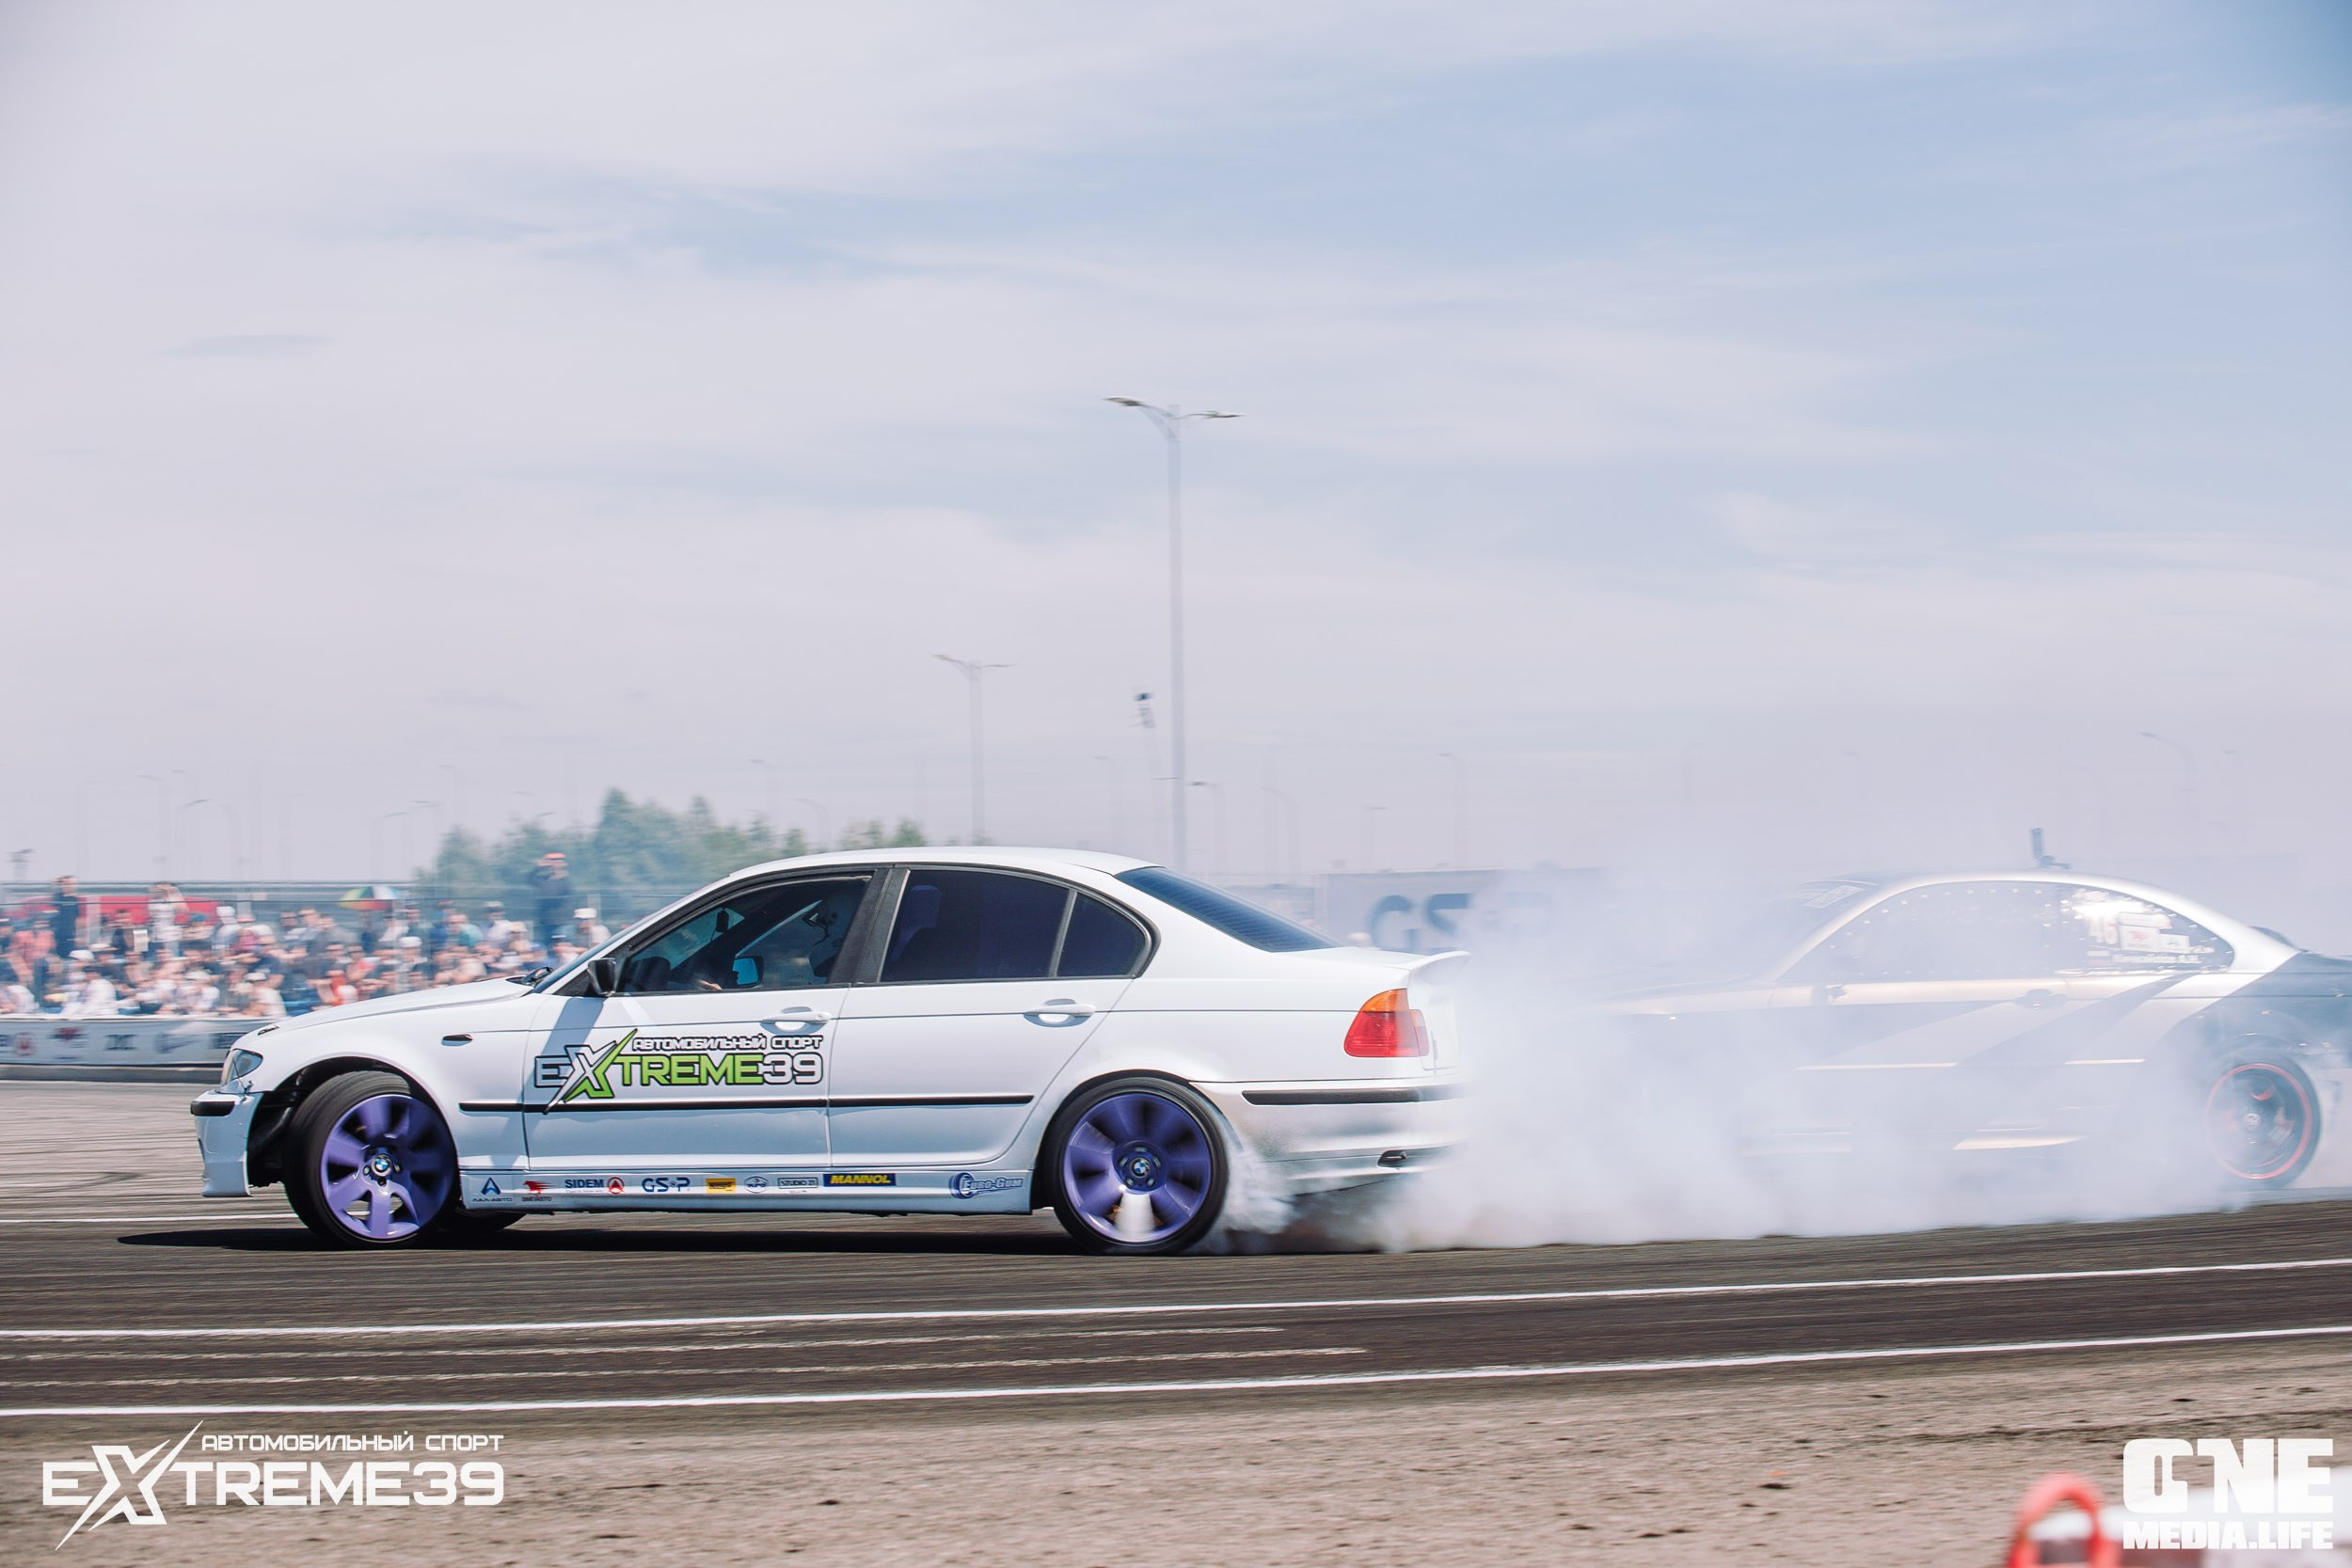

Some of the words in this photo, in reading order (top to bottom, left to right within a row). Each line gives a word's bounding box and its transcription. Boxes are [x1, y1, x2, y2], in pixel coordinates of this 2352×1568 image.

[631, 1034, 766, 1051] АВТОМОБИЛЬНЫЙ
[771, 1036, 823, 1050] СПОРТ
[535, 1028, 824, 1115] EXTREME39
[564, 1179, 604, 1189] SIDEM
[829, 1174, 891, 1184] MANNOL
